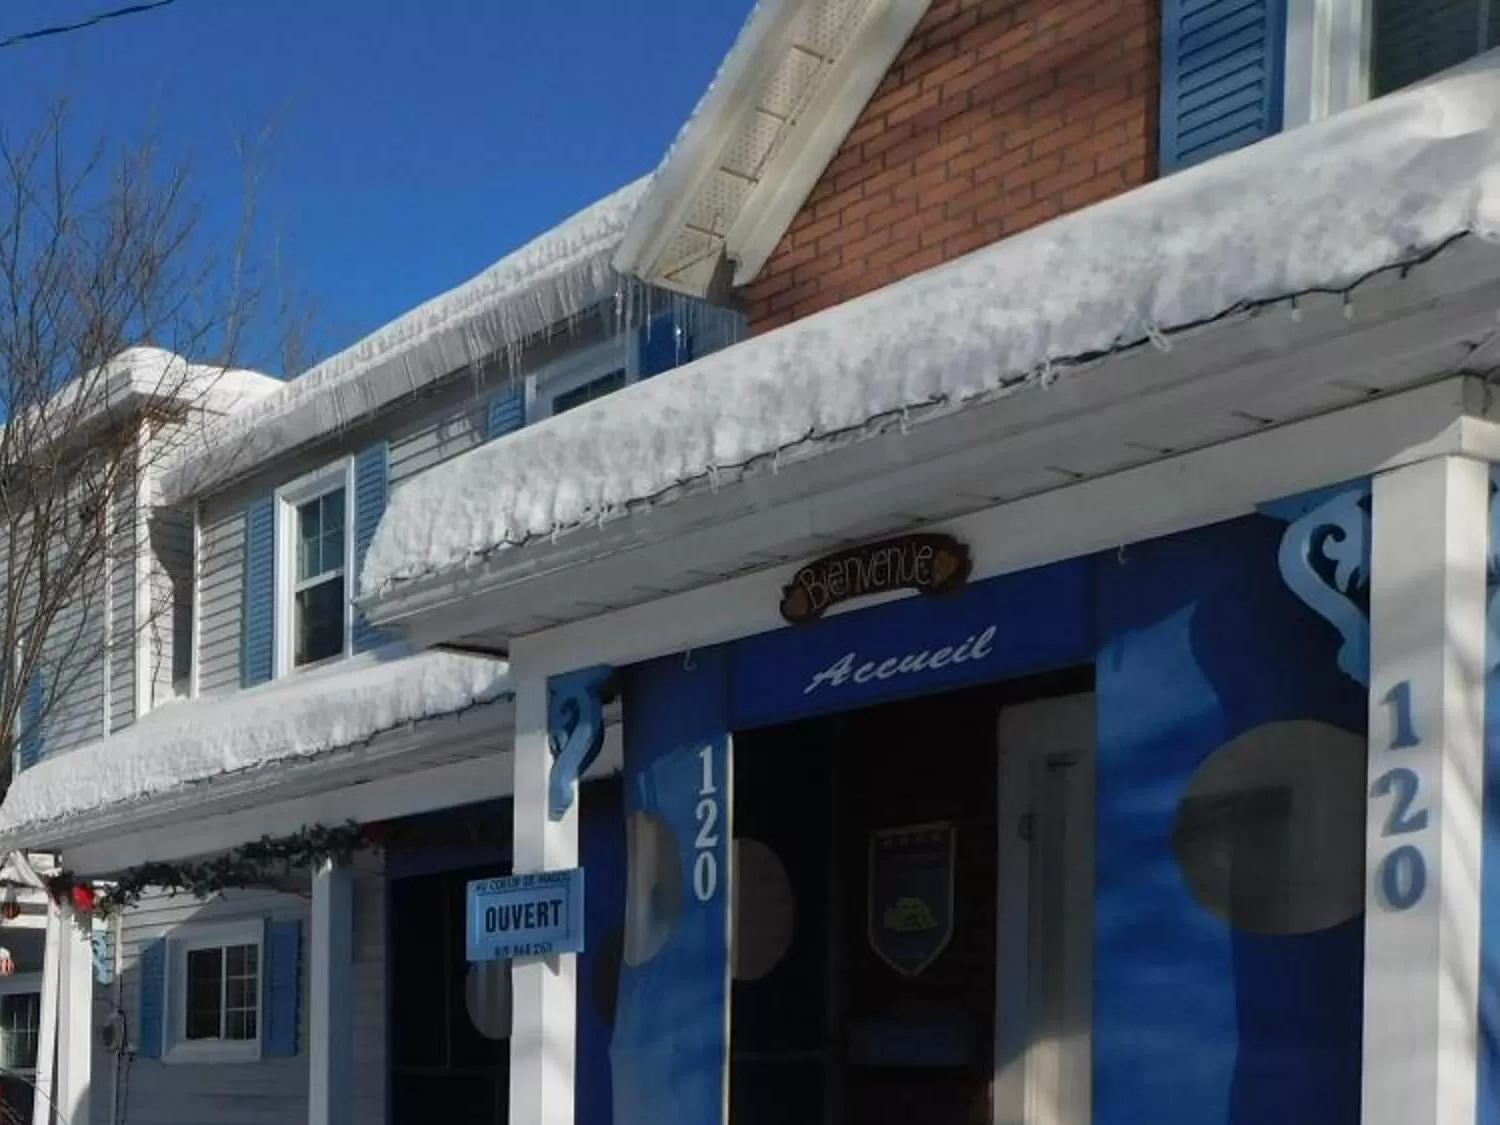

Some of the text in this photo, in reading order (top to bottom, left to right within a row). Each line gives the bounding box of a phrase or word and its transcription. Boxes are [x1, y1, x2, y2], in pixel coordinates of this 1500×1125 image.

[800, 543, 934, 610] Bienvenue
[803, 624, 998, 690] Accueil
[693, 744, 719, 902] 120
[1368, 679, 1429, 912] 120
[485, 899, 563, 933] OUVERT
